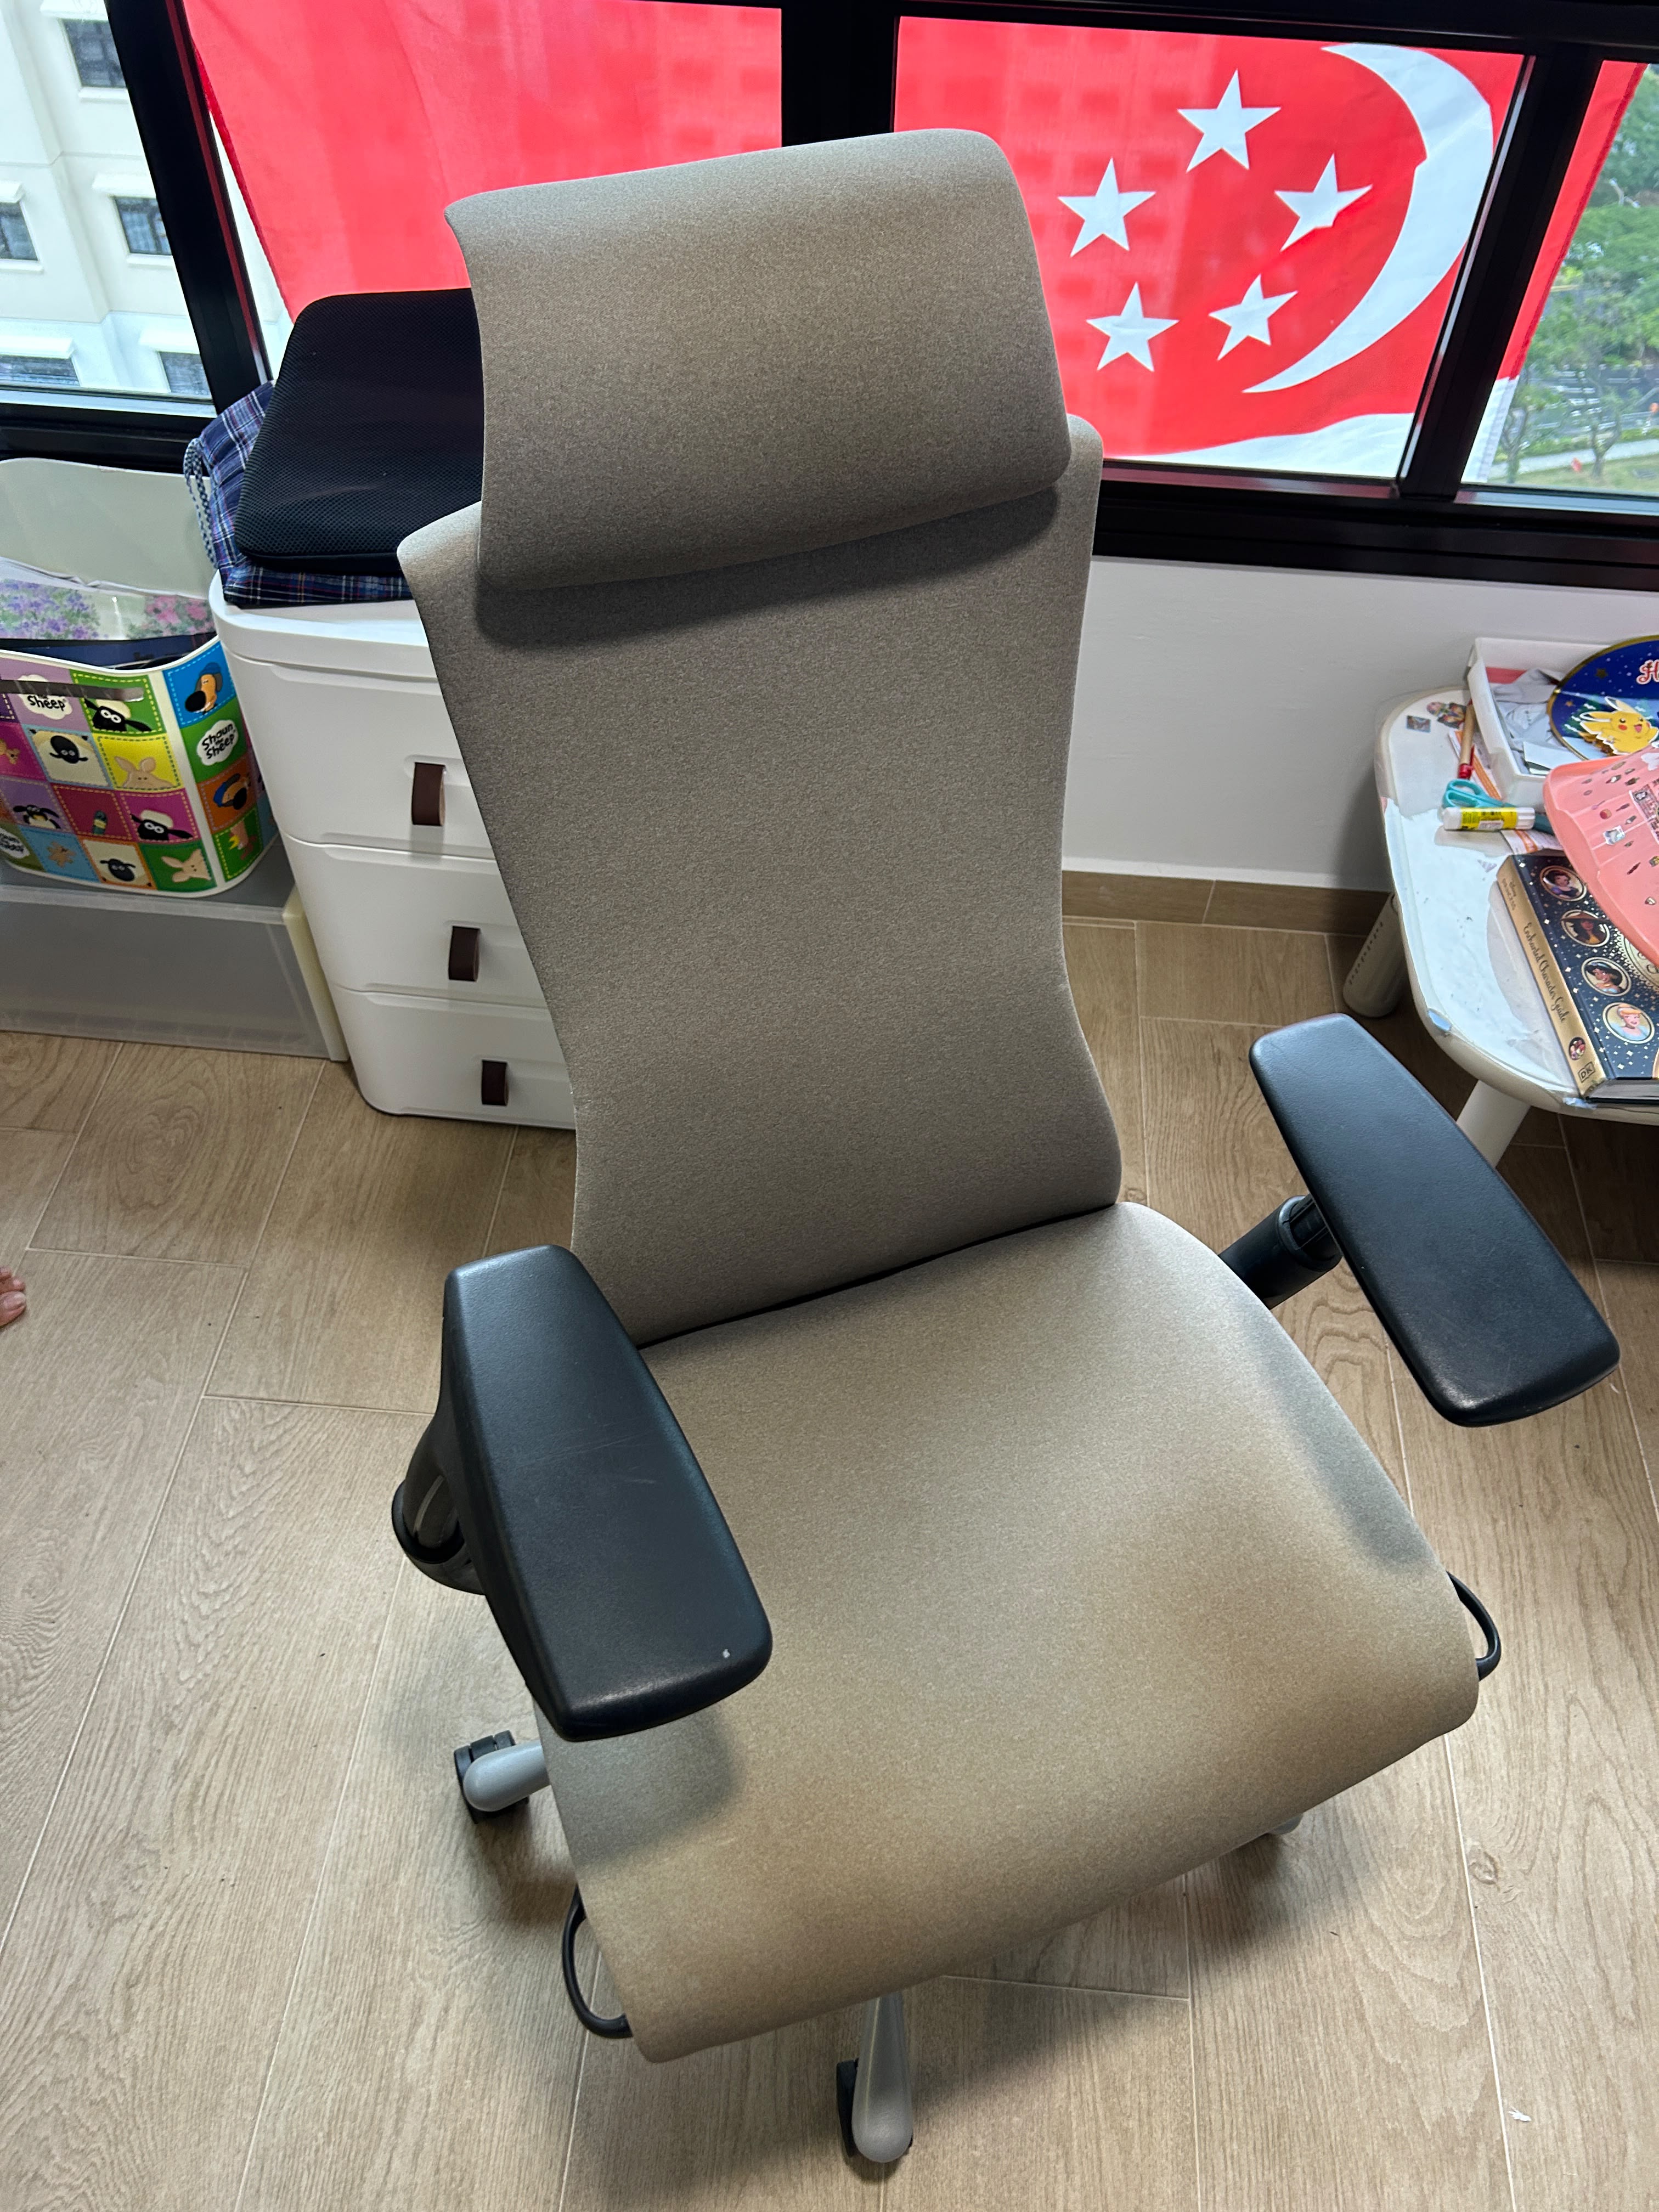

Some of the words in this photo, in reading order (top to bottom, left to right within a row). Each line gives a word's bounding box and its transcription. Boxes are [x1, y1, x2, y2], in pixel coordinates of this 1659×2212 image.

[27, 695, 65, 712] Sheep
[202, 724, 233, 751] Shaun
[206, 734, 234, 759] Sheep
[1523, 922, 1545, 963] Enchanted
[1539, 960, 1555, 1000] Character
[1551, 997, 1570, 1024] Guide
[1581, 1065, 1593, 1079] DK
